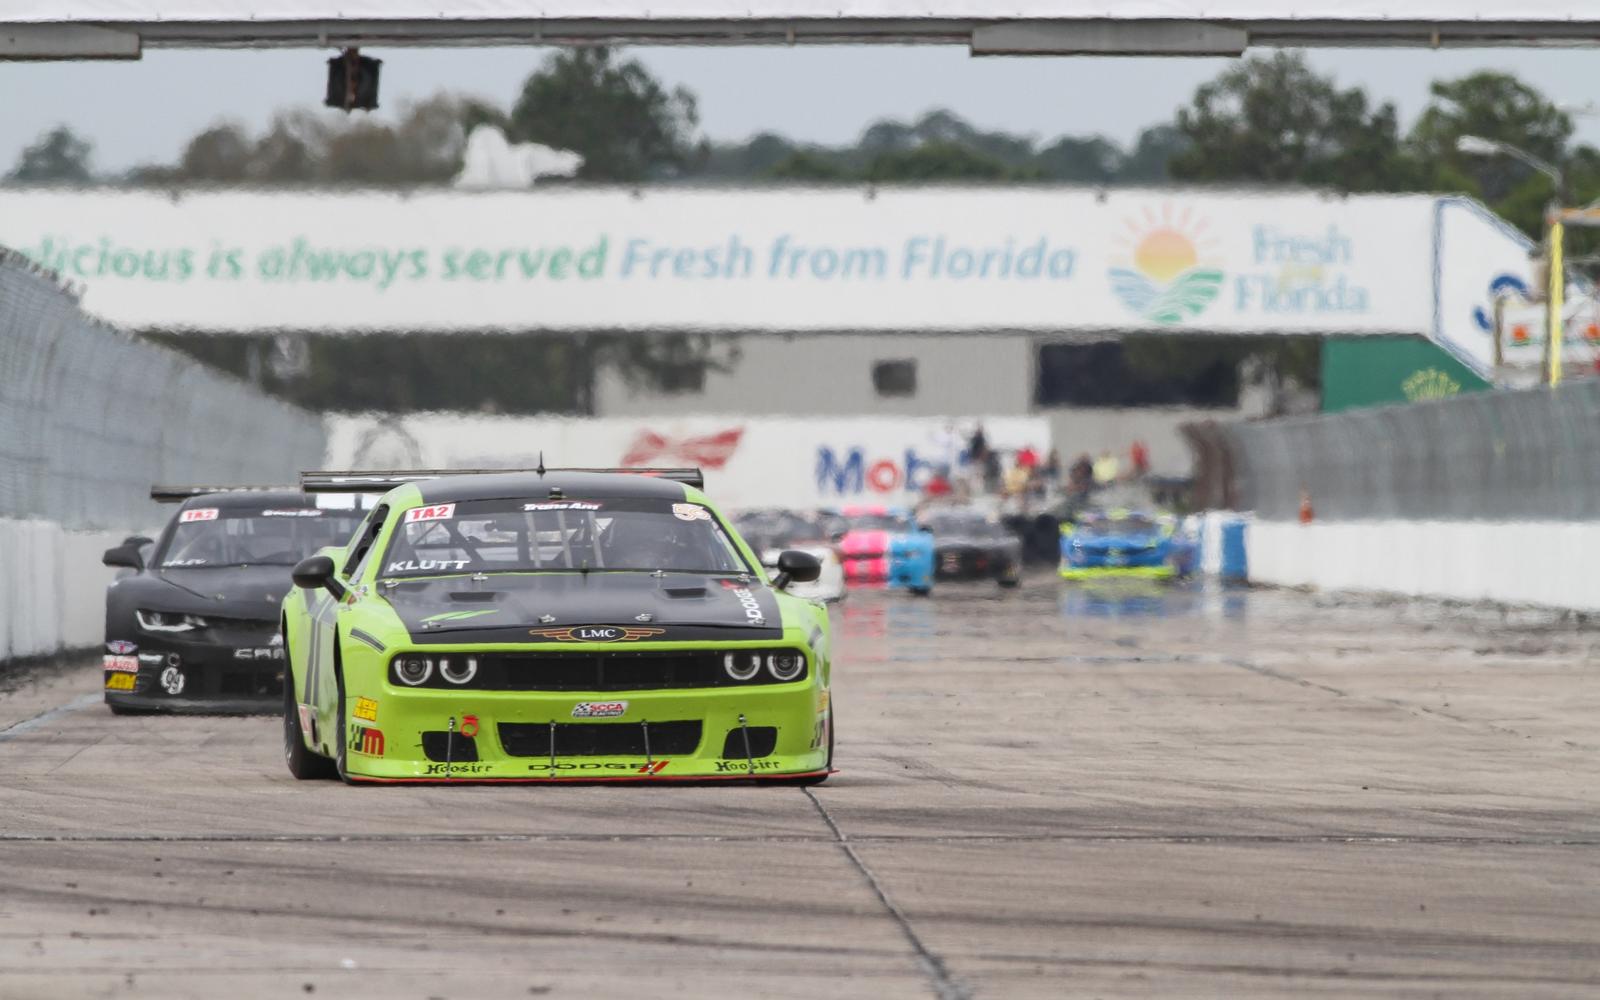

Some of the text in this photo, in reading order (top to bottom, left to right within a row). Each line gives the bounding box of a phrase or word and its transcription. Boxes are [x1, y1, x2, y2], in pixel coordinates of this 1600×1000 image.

[1252, 224, 1353, 264] Fresh
[207, 239, 242, 279] is
[258, 234, 427, 295] always
[441, 232, 608, 281] served
[620, 234, 754, 280] Fresh
[767, 234, 889, 280] from
[902, 235, 1078, 280] Florida
[1235, 273, 1369, 312] Florida
[523, 501, 600, 511] Trans Am
[411, 506, 448, 520] TA2
[388, 559, 470, 572] KLUTT
[733, 587, 764, 622] DODGE
[580, 629, 616, 639] LMC
[590, 703, 624, 712] SCCA
[528, 763, 643, 771] DODGE
